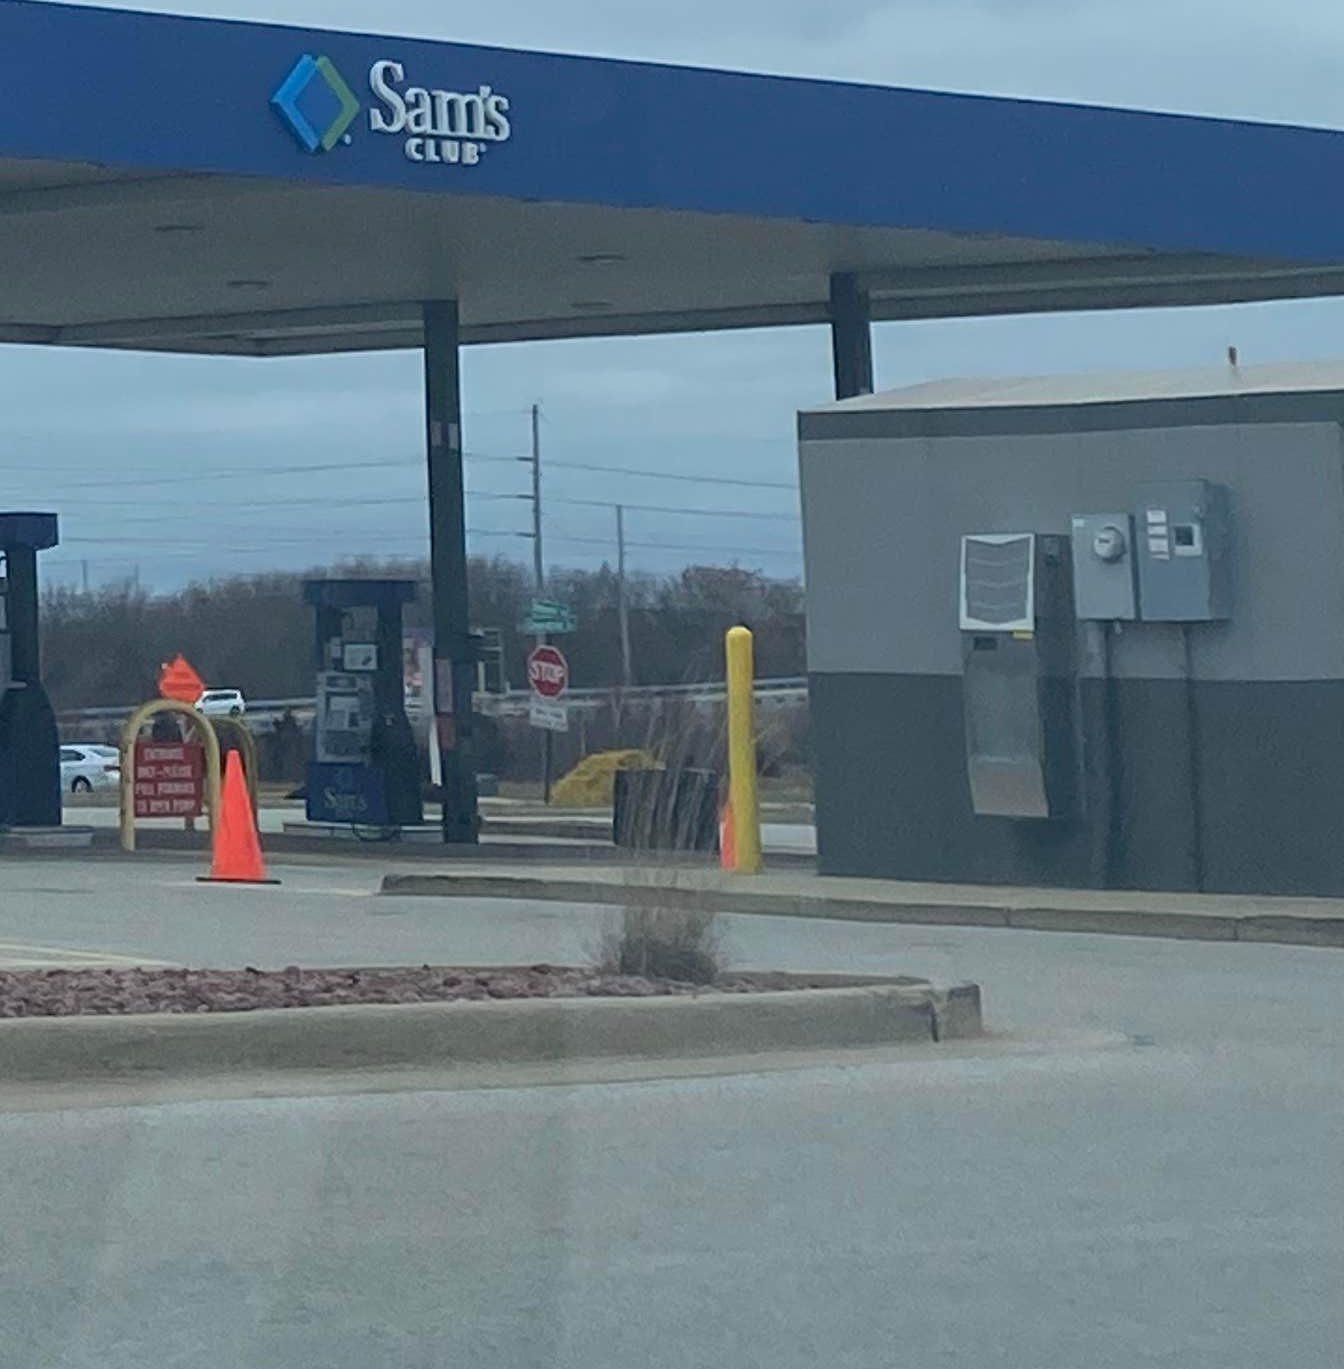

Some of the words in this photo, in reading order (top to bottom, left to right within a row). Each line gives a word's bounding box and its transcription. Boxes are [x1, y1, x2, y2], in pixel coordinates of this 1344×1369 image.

[369, 60, 511, 142] Sam's
[404, 138, 482, 165] CLUB
[529, 660, 566, 684] STOP
